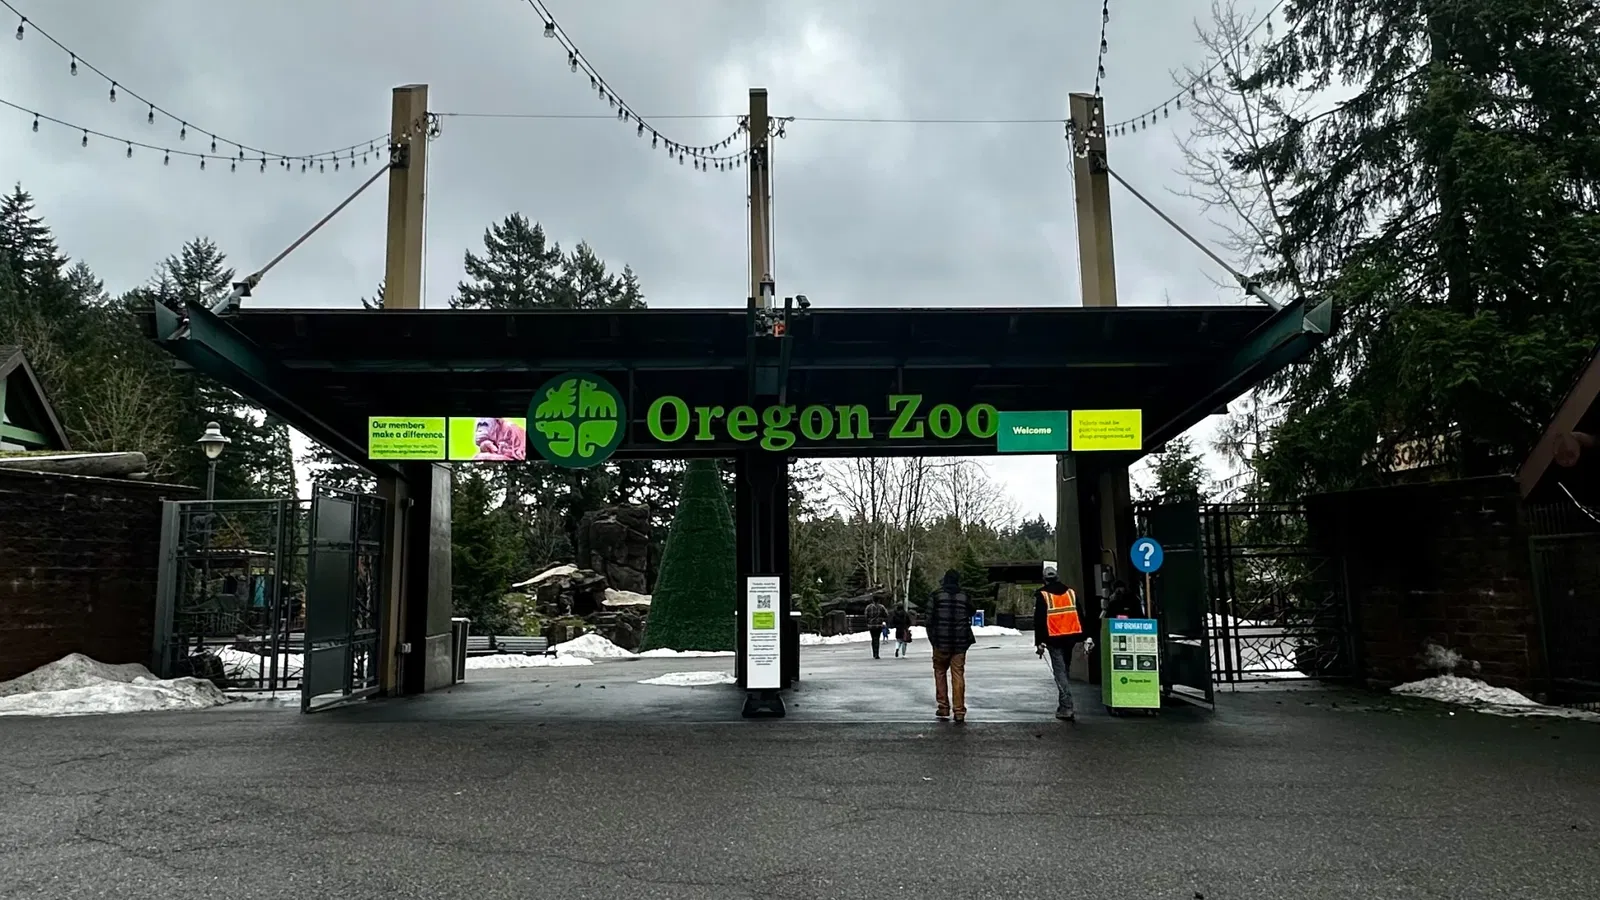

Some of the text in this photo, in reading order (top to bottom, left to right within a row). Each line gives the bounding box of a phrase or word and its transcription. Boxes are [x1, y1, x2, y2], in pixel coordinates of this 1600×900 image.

[372, 421, 426, 429] Our members
[646, 394, 1000, 451] Oregon Zoo
[372, 430, 394, 438] make
[402, 430, 445, 438] difference.
[1012, 426, 1052, 434] Welcome
[1139, 543, 1155, 567] ?
[1114, 622, 1153, 630] INFORMATION
